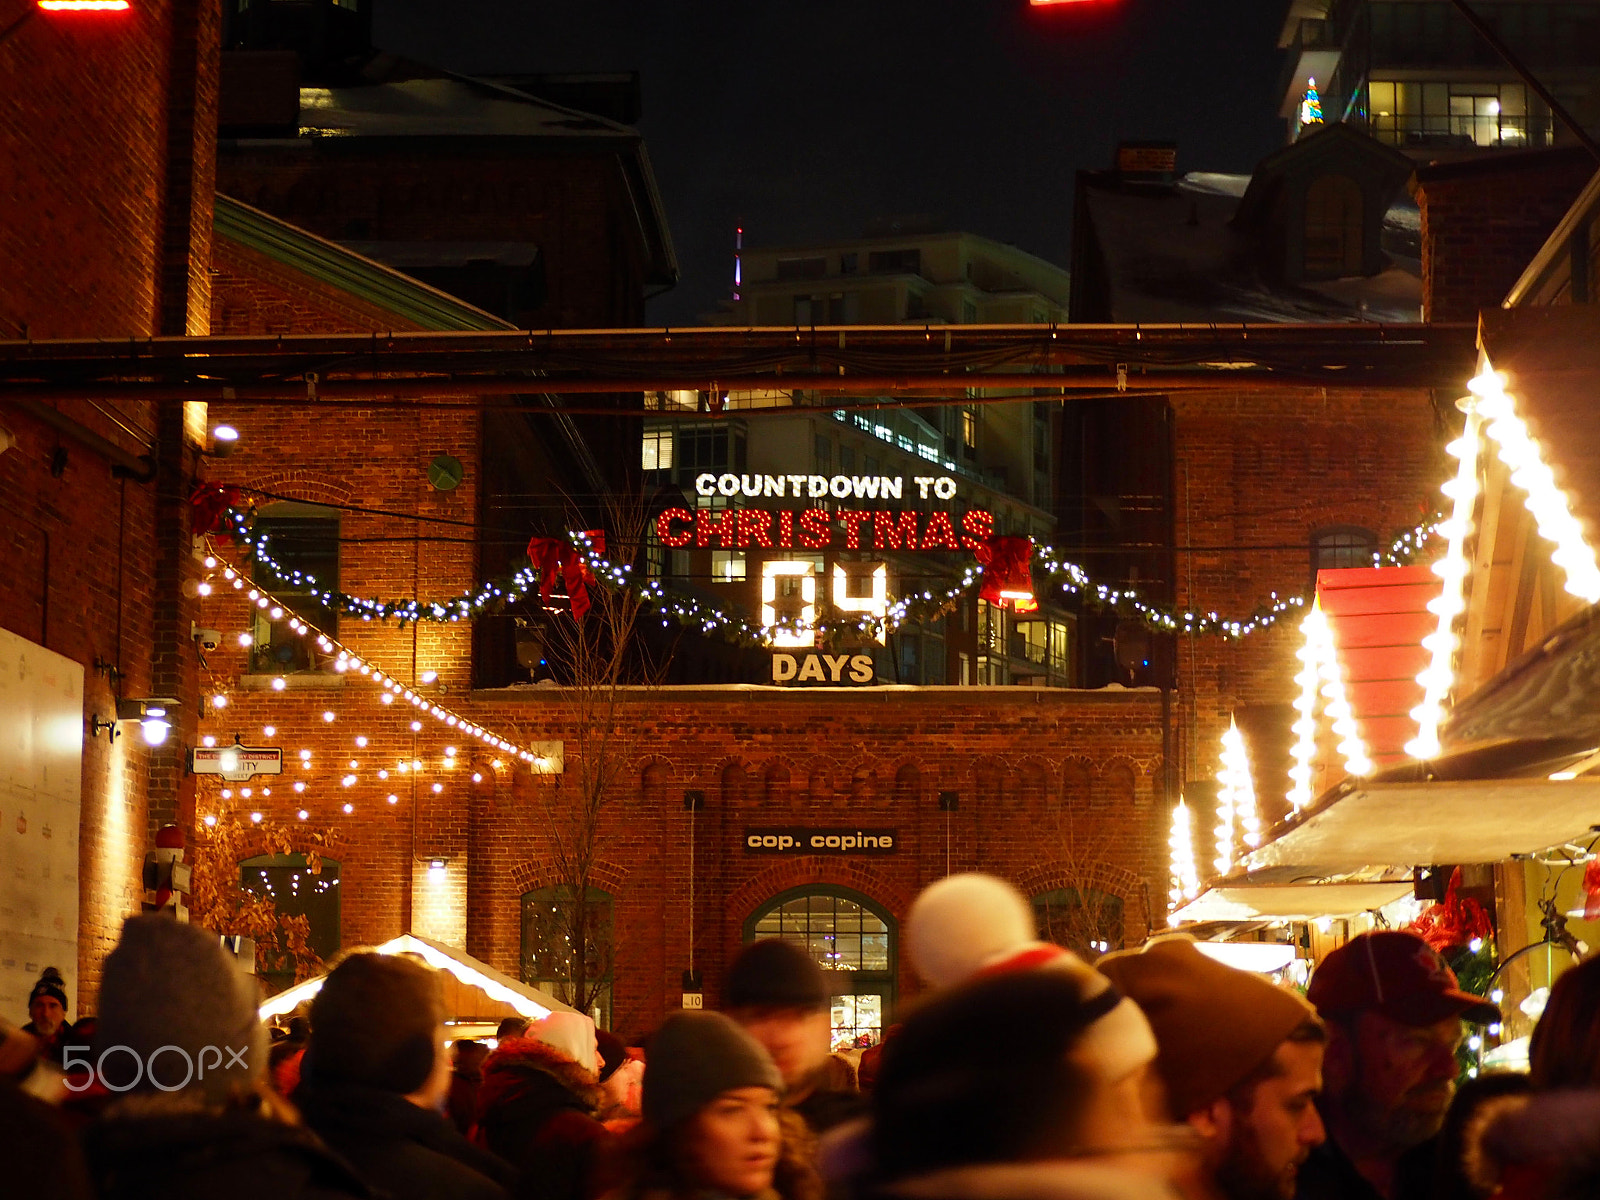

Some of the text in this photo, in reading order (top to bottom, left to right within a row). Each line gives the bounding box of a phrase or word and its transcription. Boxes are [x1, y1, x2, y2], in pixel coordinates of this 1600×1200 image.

[695, 473, 957, 499] COUNTDOWN TO
[656, 507, 995, 550] CHRISTMAS
[761, 560, 887, 648] 04
[772, 653, 874, 682] DAYS
[747, 831, 893, 850] cop. copine
[690, 996, 701, 1006] 10
